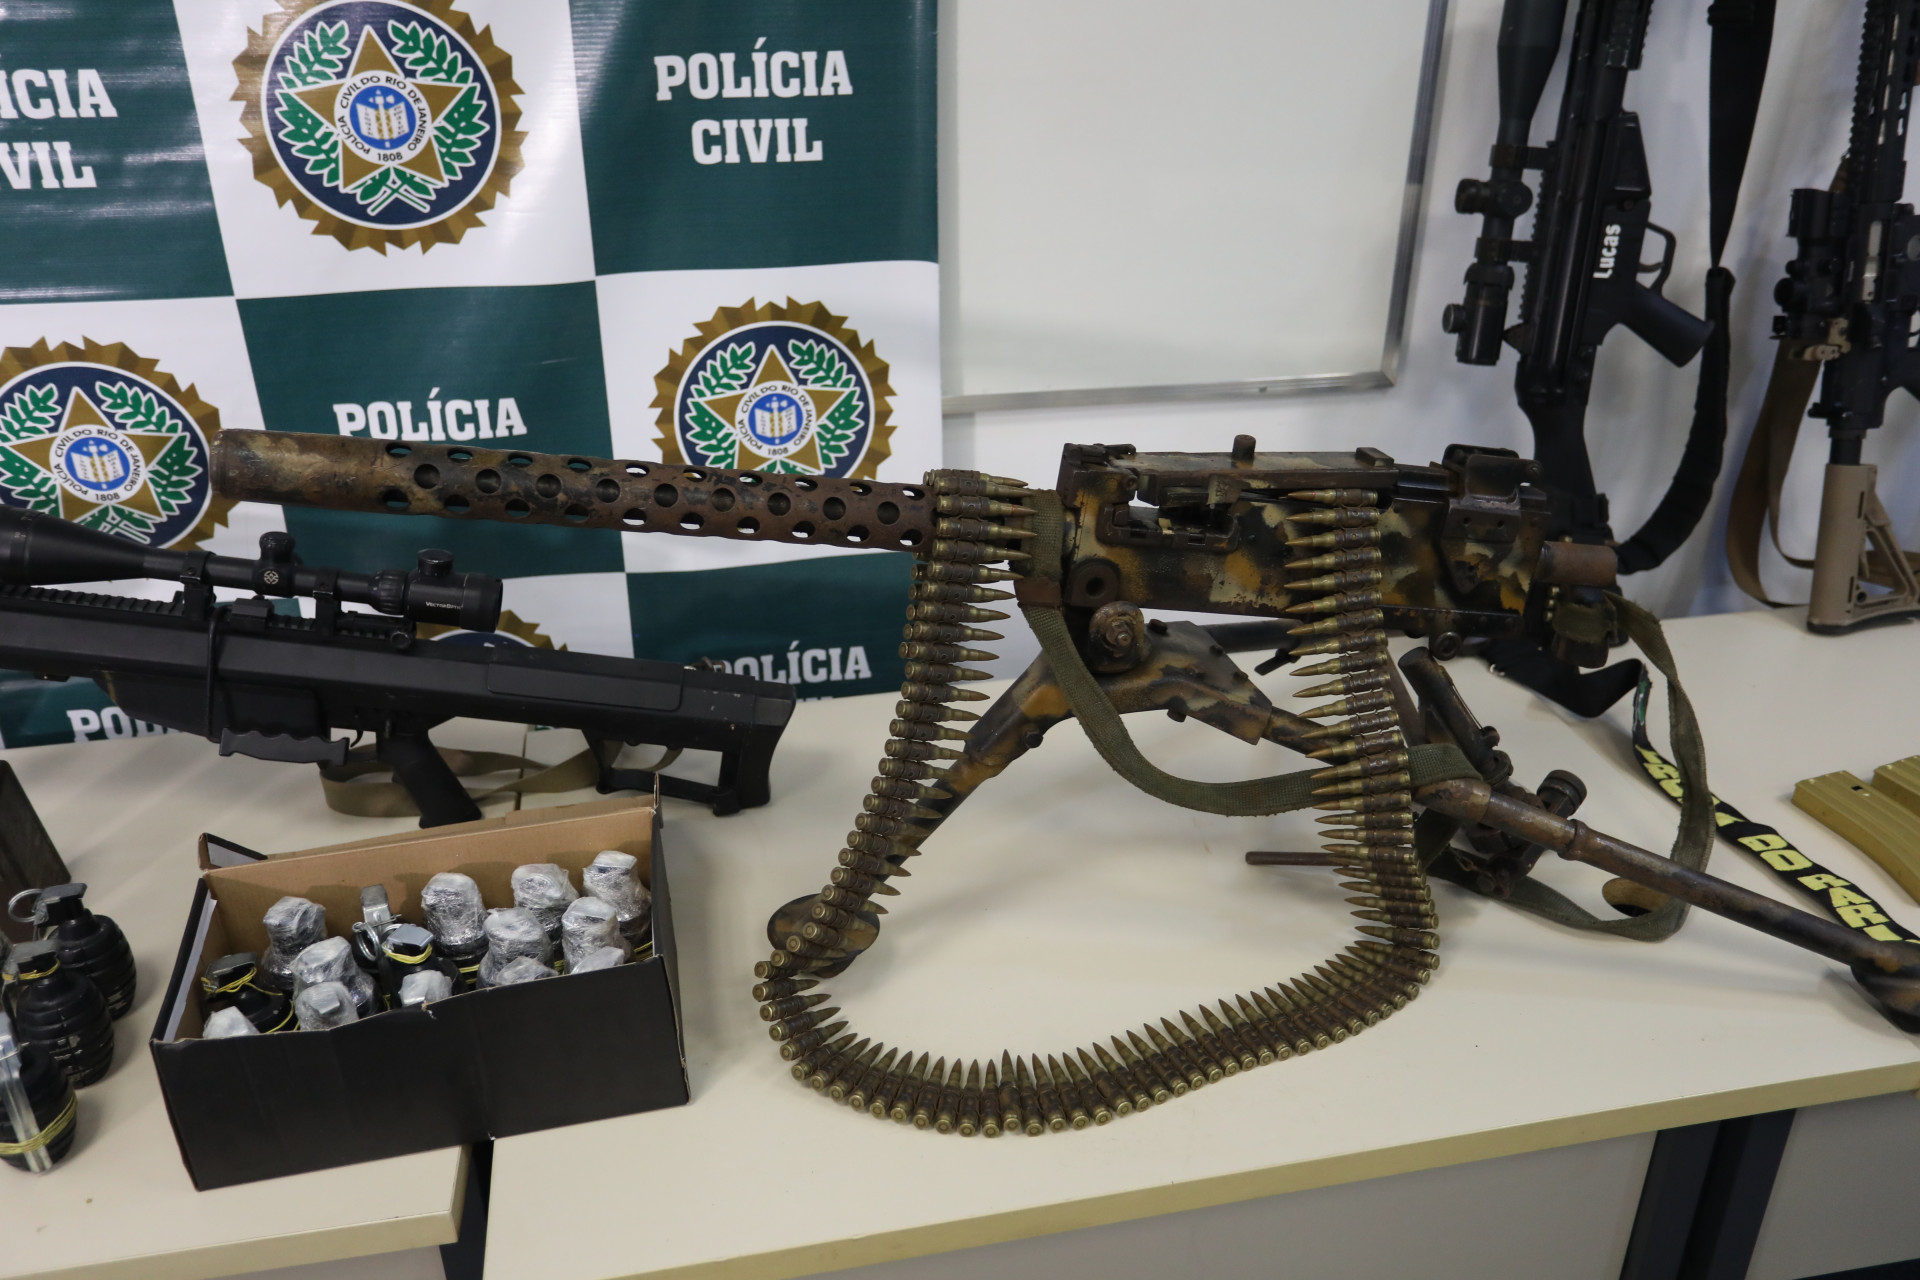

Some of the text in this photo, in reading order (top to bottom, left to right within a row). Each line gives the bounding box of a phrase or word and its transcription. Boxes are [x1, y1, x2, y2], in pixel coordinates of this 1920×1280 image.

[654, 37, 854, 101] POLÍCIA
[338, 75, 427, 154] POLÍCIA CIVIL DO RIO DE JANEIRO
[377, 152, 403, 162] 1808
[691, 118, 823, 165] CIVIL
[1592, 224, 1621, 279] Lucas
[333, 387, 528, 441] POLÍCIA
[54, 429, 141, 496] POLÍCIA CIVIL DO RIO DE JANEIRO
[768, 447, 789, 455] 1808
[95, 492, 120, 501] 1808
[1737, 833, 1813, 872] DO
